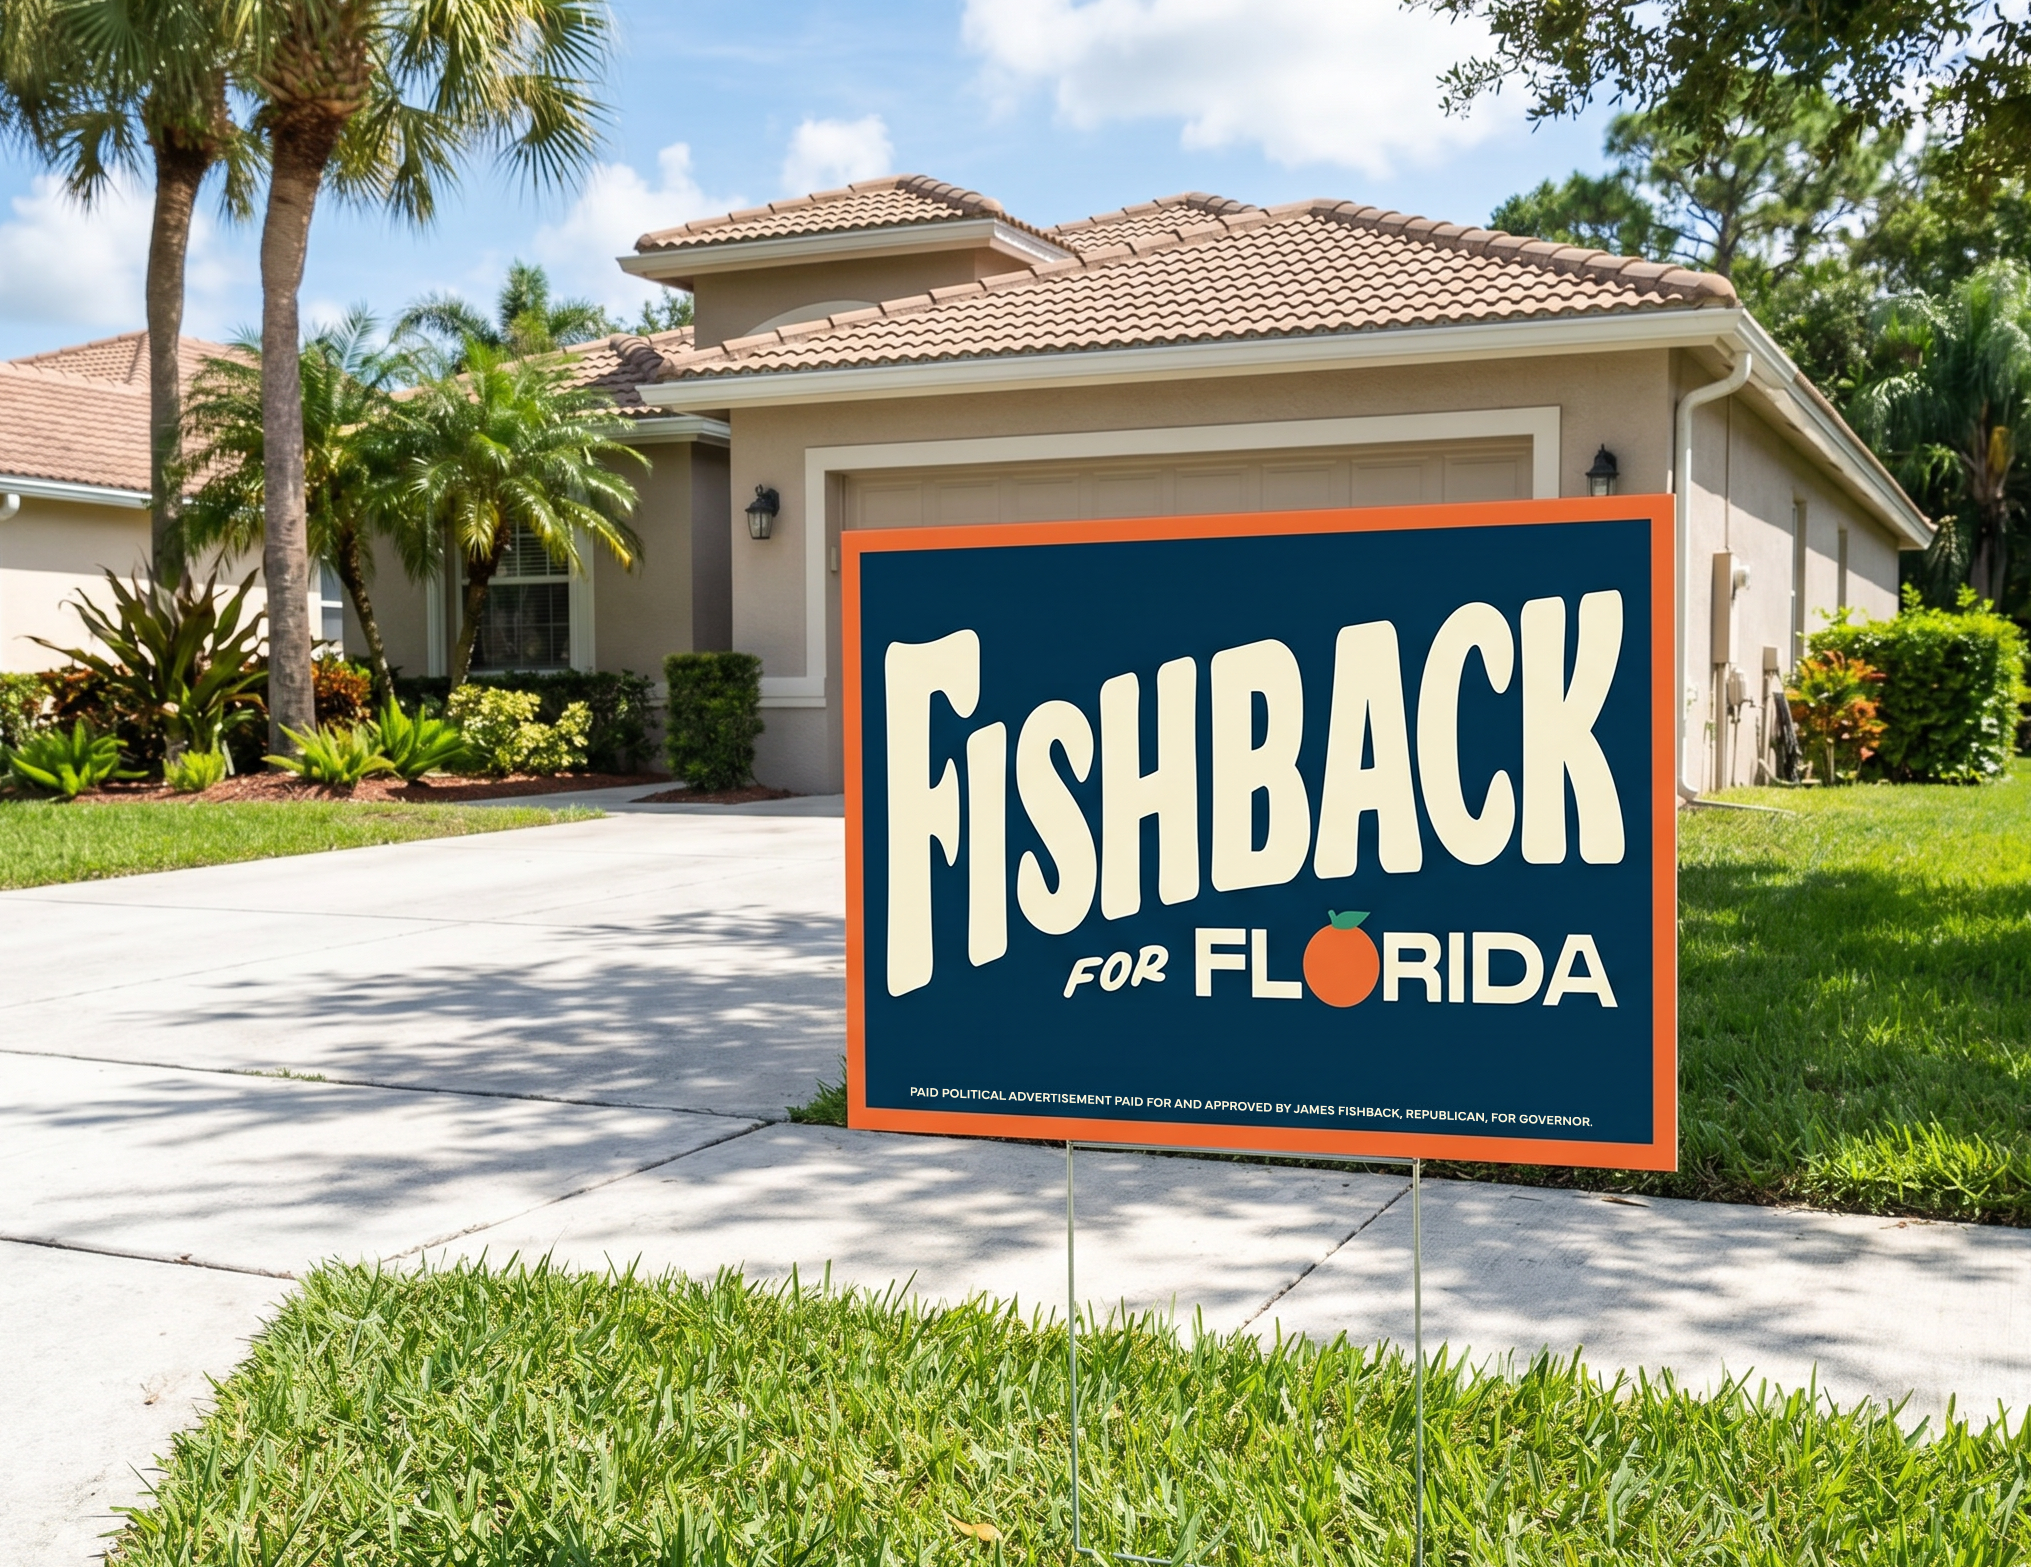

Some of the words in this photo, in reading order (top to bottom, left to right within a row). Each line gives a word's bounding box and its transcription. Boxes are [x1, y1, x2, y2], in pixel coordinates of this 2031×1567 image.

[885, 590, 1625, 997] FISHBACK
[1063, 944, 1169, 999] FOR
[1195, 922, 1618, 1008] FLORIDA
[910, 1086, 939, 1098] PAID
[941, 1088, 1007, 1101] POLITICAL
[1007, 1091, 1113, 1106] ADVERTISEMENT
[1114, 1095, 1144, 1107] PAID
[1146, 1097, 1172, 1109] FOR
[1173, 1098, 1203, 1110] AND
[1204, 1100, 1273, 1113] APPROVED
[1275, 1103, 1292, 1114] BY
[1293, 1104, 1336, 1116] JAMES
[1338, 1105, 1403, 1120] FISHBACK,
[1405, 1108, 1489, 1124] REPUBLICAN,
[1491, 1112, 1517, 1124] FOR
[1518, 1114, 1593, 1127] GOVERNOR.
